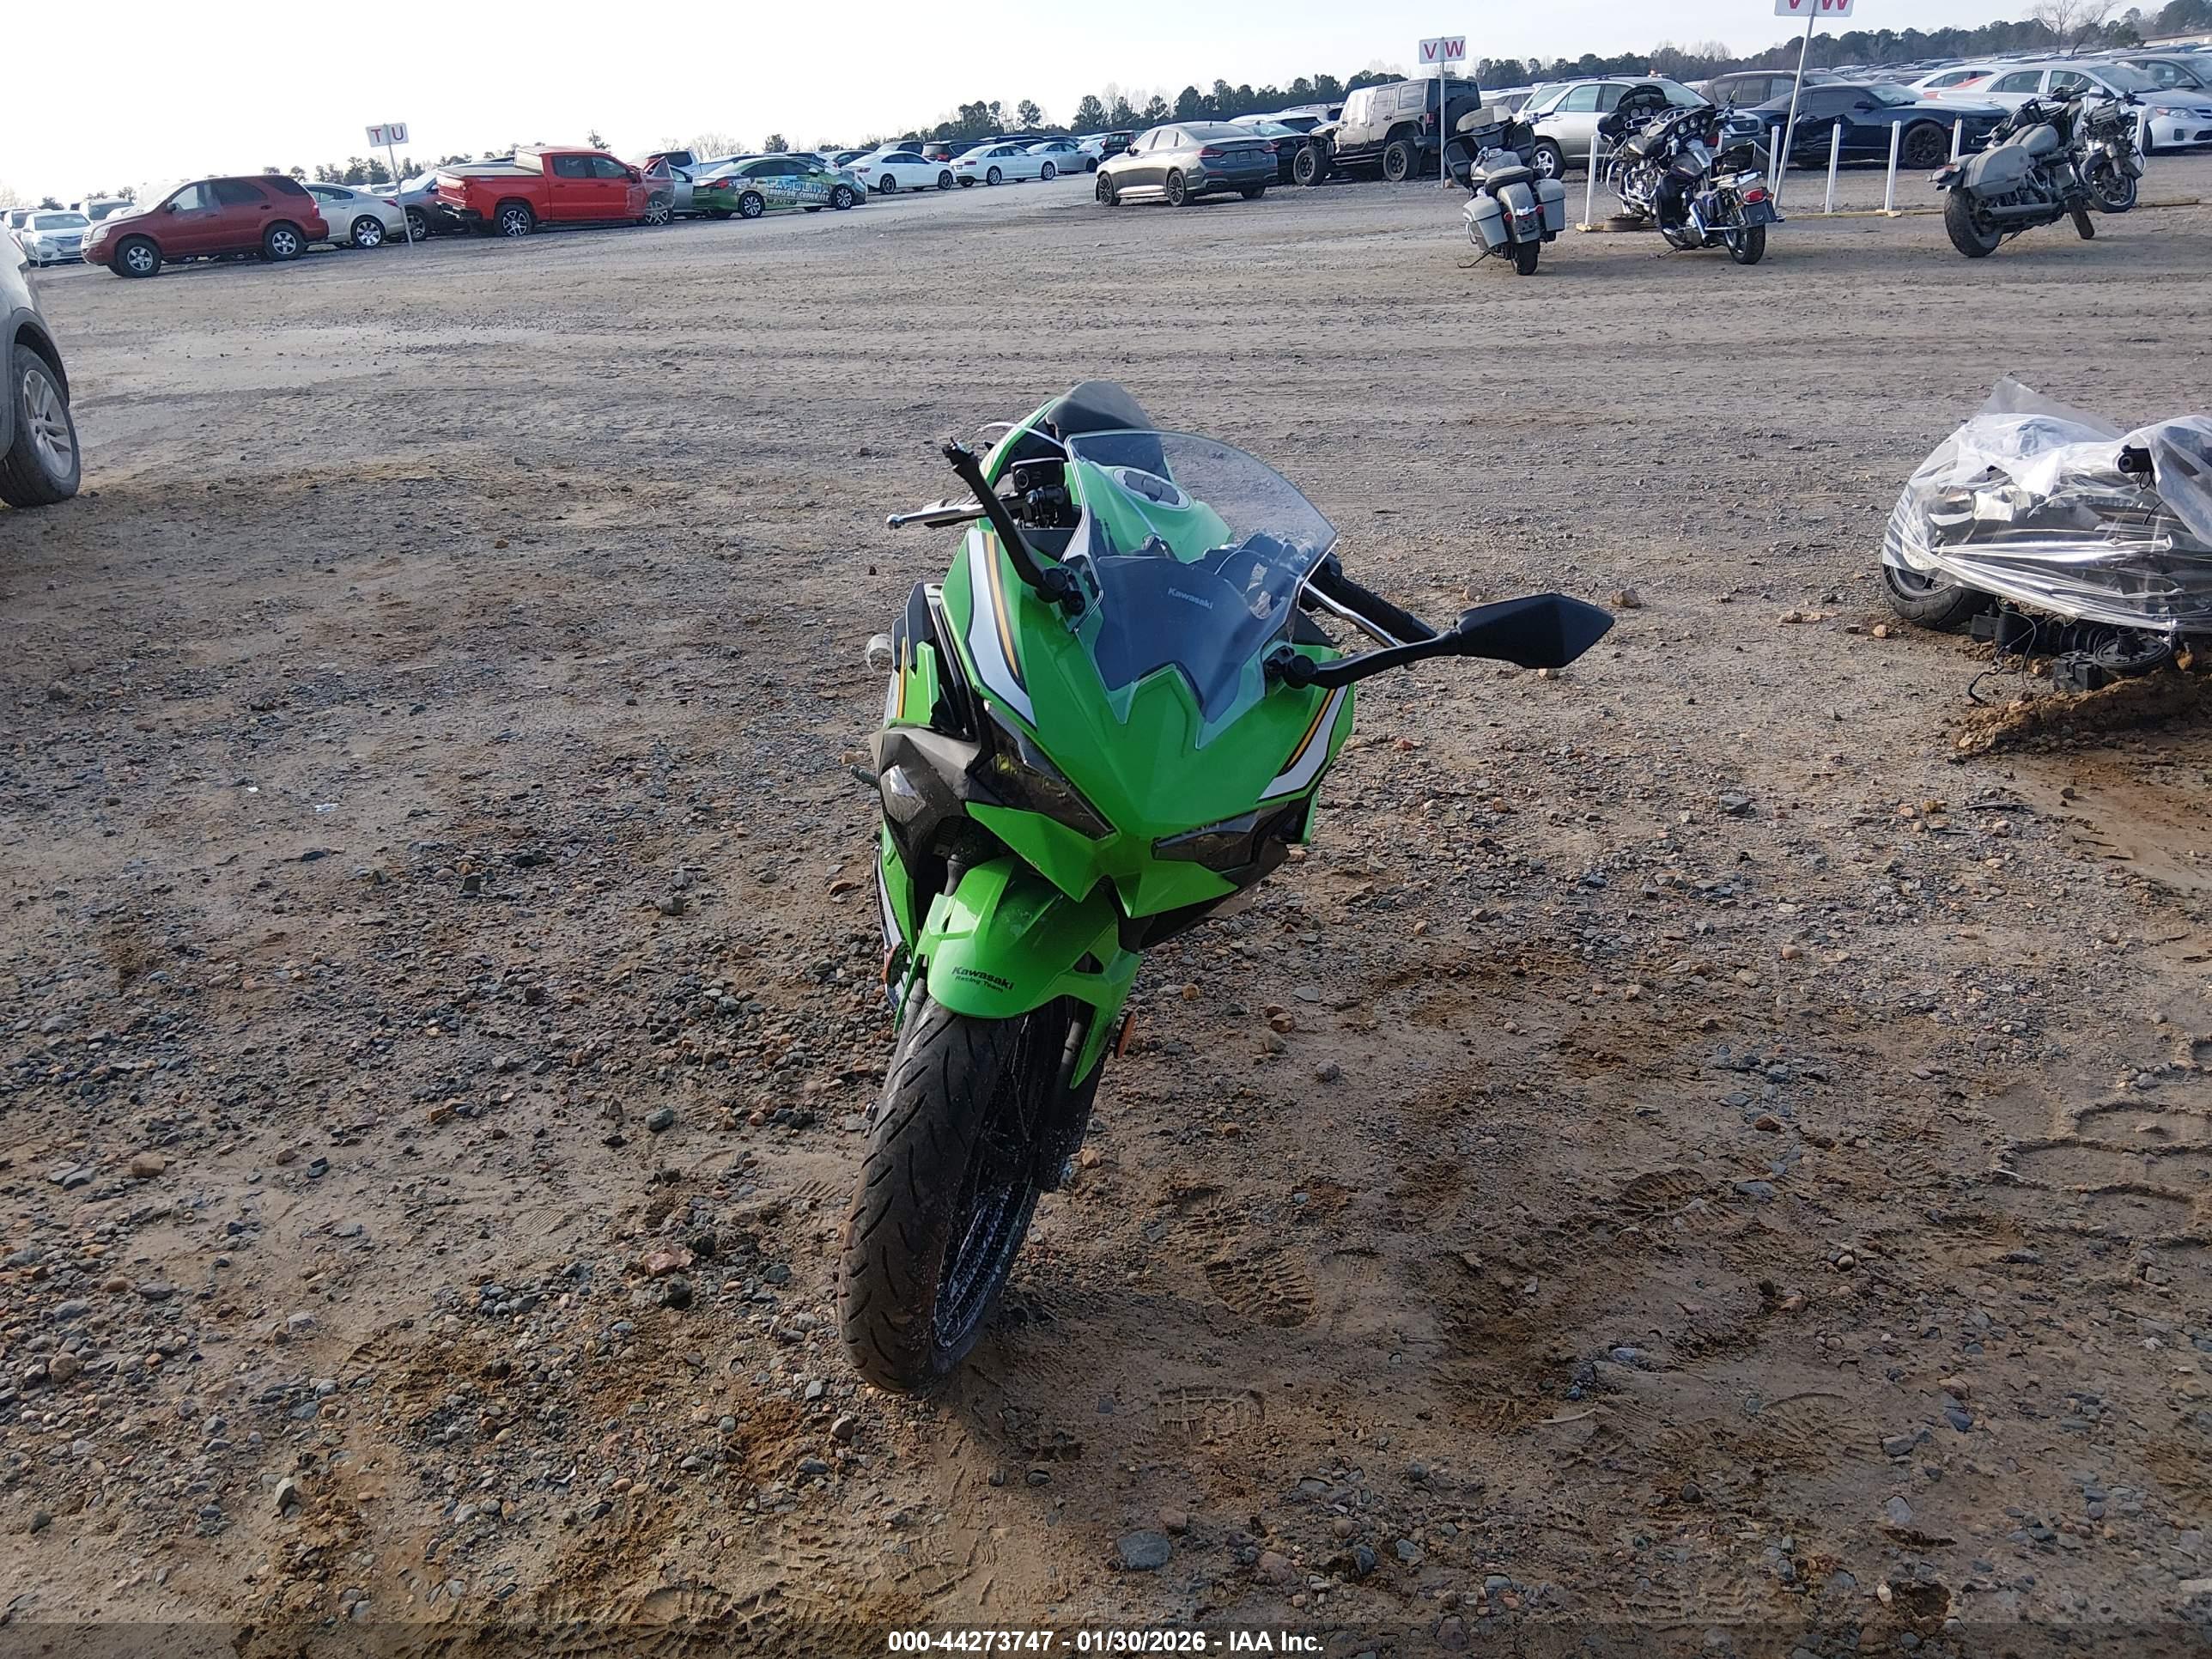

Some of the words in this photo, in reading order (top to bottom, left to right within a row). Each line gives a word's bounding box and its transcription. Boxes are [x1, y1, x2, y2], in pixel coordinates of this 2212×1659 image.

[1424, 43, 1437, 59] V
[1444, 40, 1464, 57] W
[370, 129, 381, 143] T
[391, 125, 404, 141] U
[1168, 586, 1213, 610] Kawasaki
[951, 966, 1015, 990] Kawasaki
[954, 975, 981, 985] Racing
[983, 980, 1004, 994] Team
